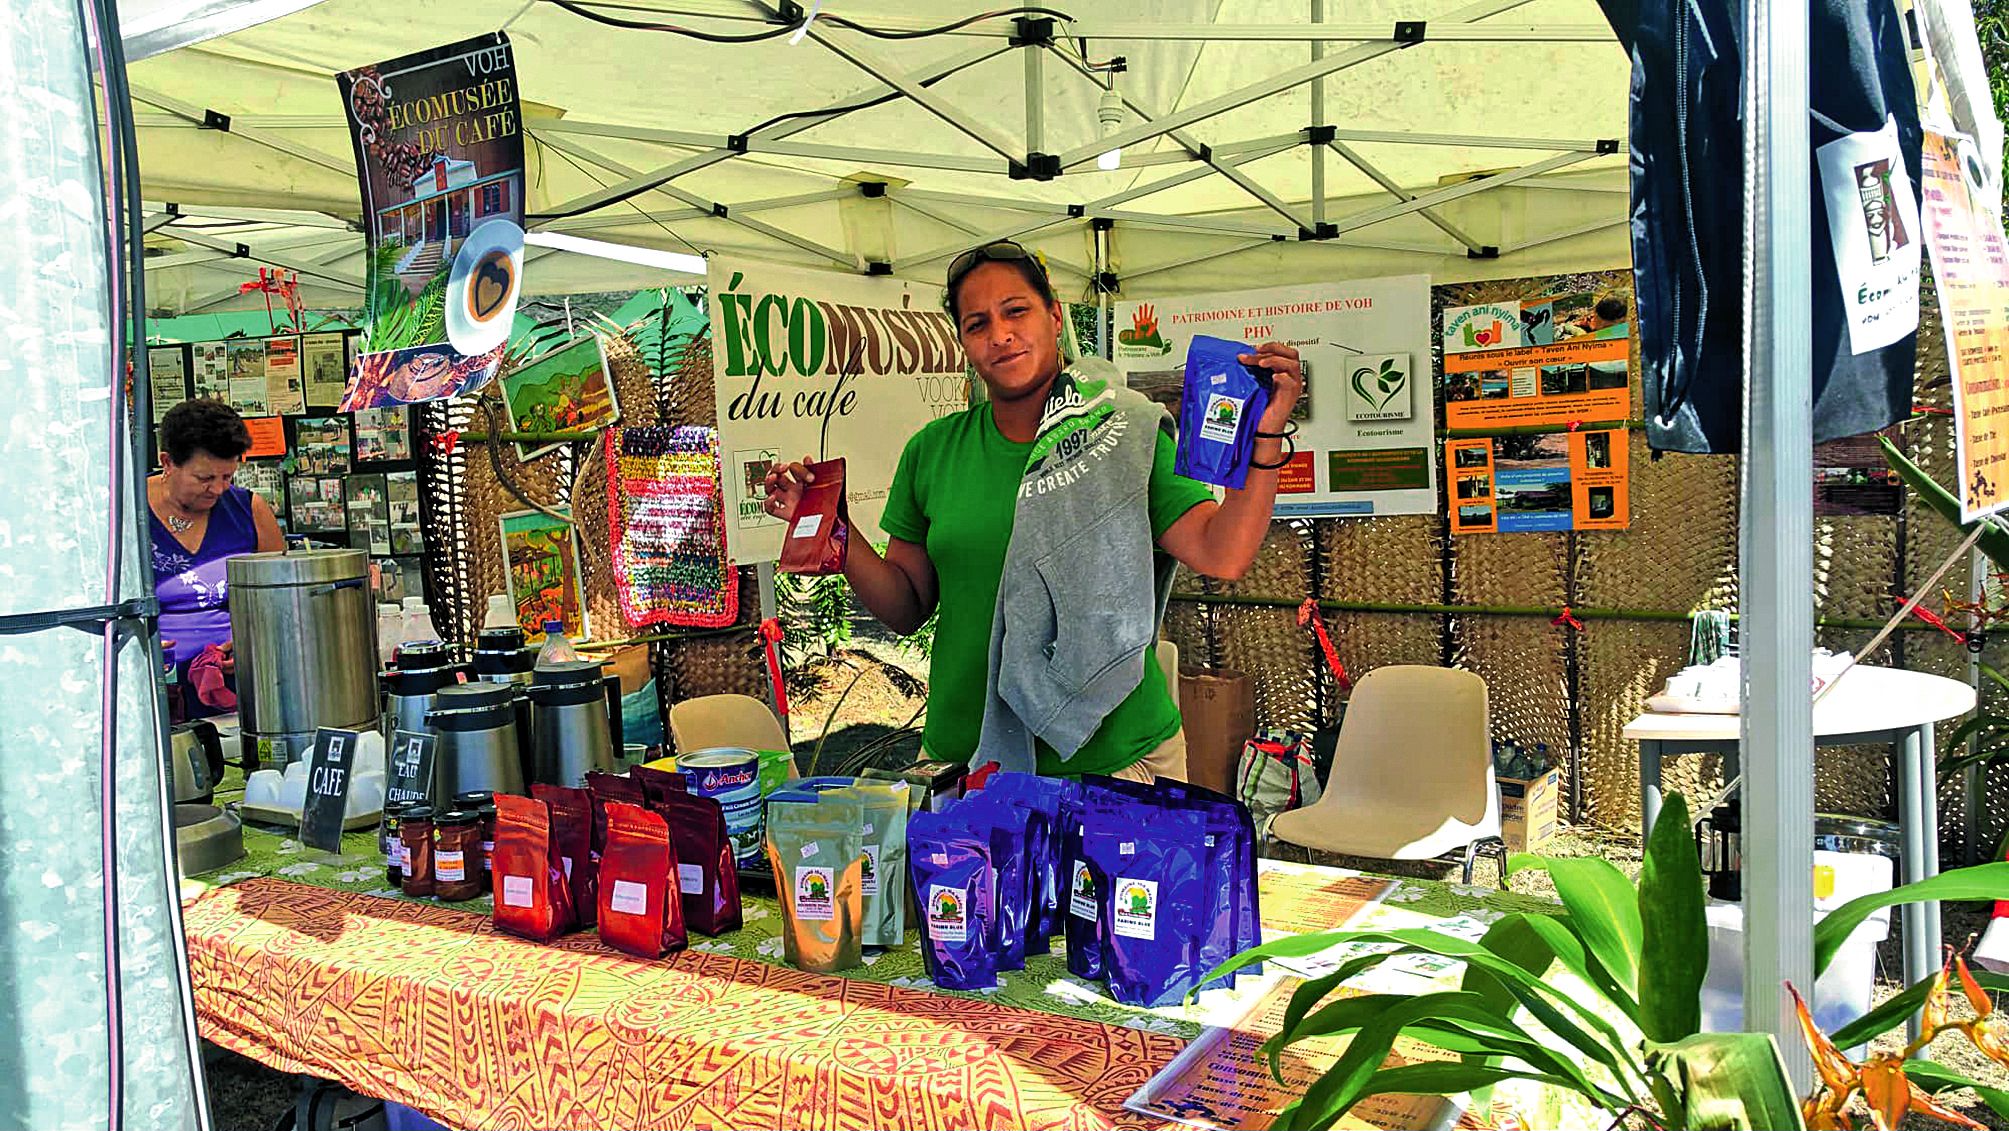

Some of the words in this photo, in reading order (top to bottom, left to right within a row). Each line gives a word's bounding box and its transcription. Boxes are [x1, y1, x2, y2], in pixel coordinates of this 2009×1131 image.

[463, 47, 510, 78] VOH
[387, 78, 513, 132] ÉCOMUSÉE
[418, 129, 450, 155] DU
[455, 110, 516, 146] CAFÉ
[718, 271, 967, 378] ÉCOMUSÉE
[1172, 308, 1246, 324] PATRIMOINE
[1247, 307, 1263, 318] ET
[1265, 302, 1323, 317] HISTOIRE
[1325, 299, 1342, 310] DE
[1344, 297, 1373, 309] VOH
[1444, 311, 1471, 337] taven
[1471, 305, 1490, 317] ani
[1490, 305, 1520, 332] nyima
[1243, 325, 1275, 339] PHV
[728, 354, 784, 421] du
[793, 336, 868, 462] café
[1056, 428, 1087, 459] 1997
[1357, 428, 1404, 437] Ecotourisme
[1037, 460, 1090, 495] CREATE
[1088, 419, 1129, 461] TRUTH
[312, 766, 345, 797] CAFE
[398, 763, 419, 779] EAU
